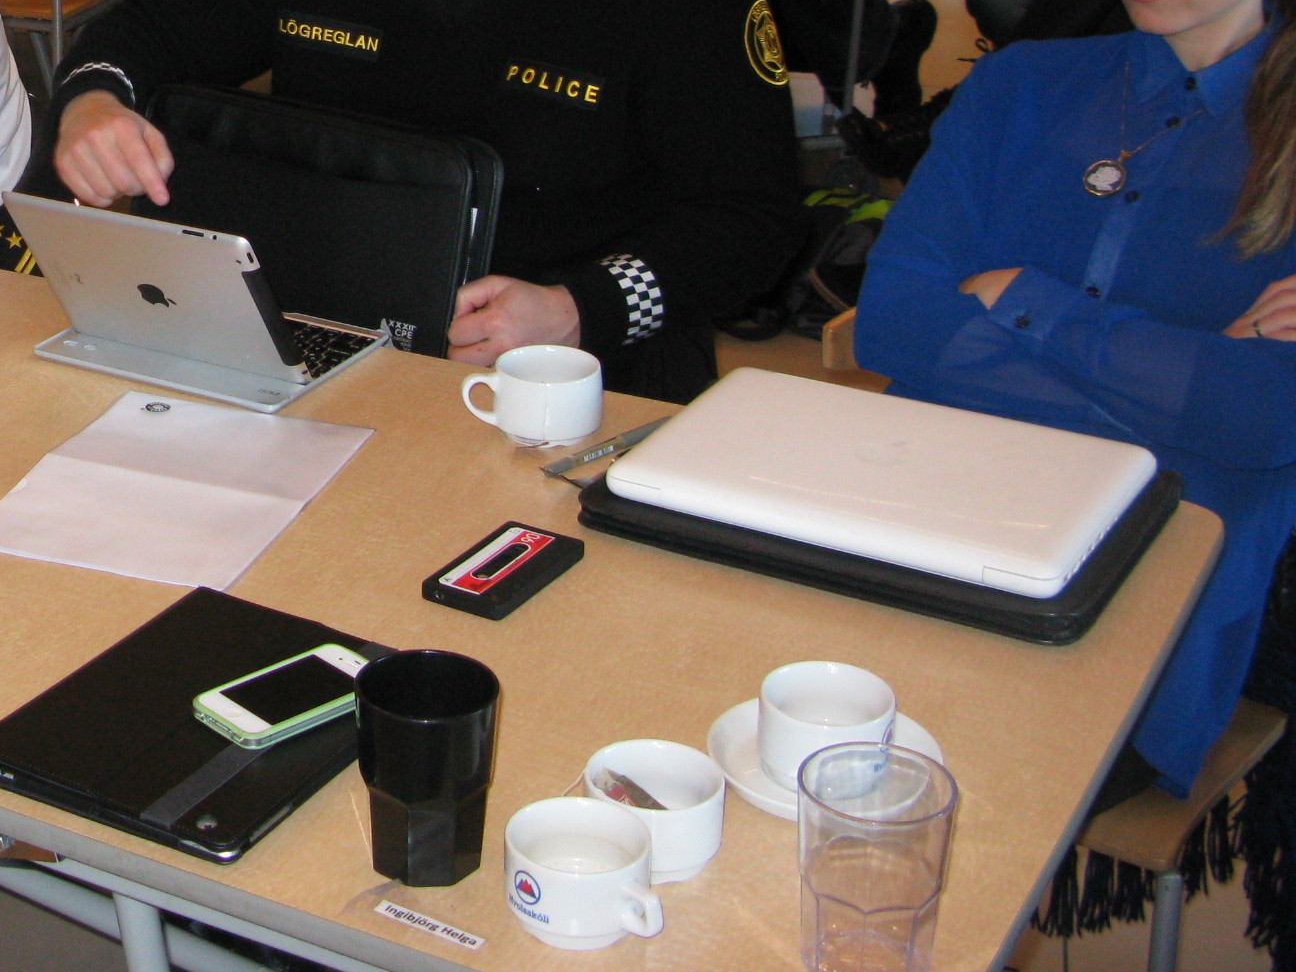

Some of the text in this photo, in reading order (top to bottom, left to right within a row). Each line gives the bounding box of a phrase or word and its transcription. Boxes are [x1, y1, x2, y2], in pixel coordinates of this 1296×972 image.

[279, 18, 379, 53] LÖGREGLAN
[506, 64, 601, 104] POLICE
[440, 926, 477, 946] Helga
